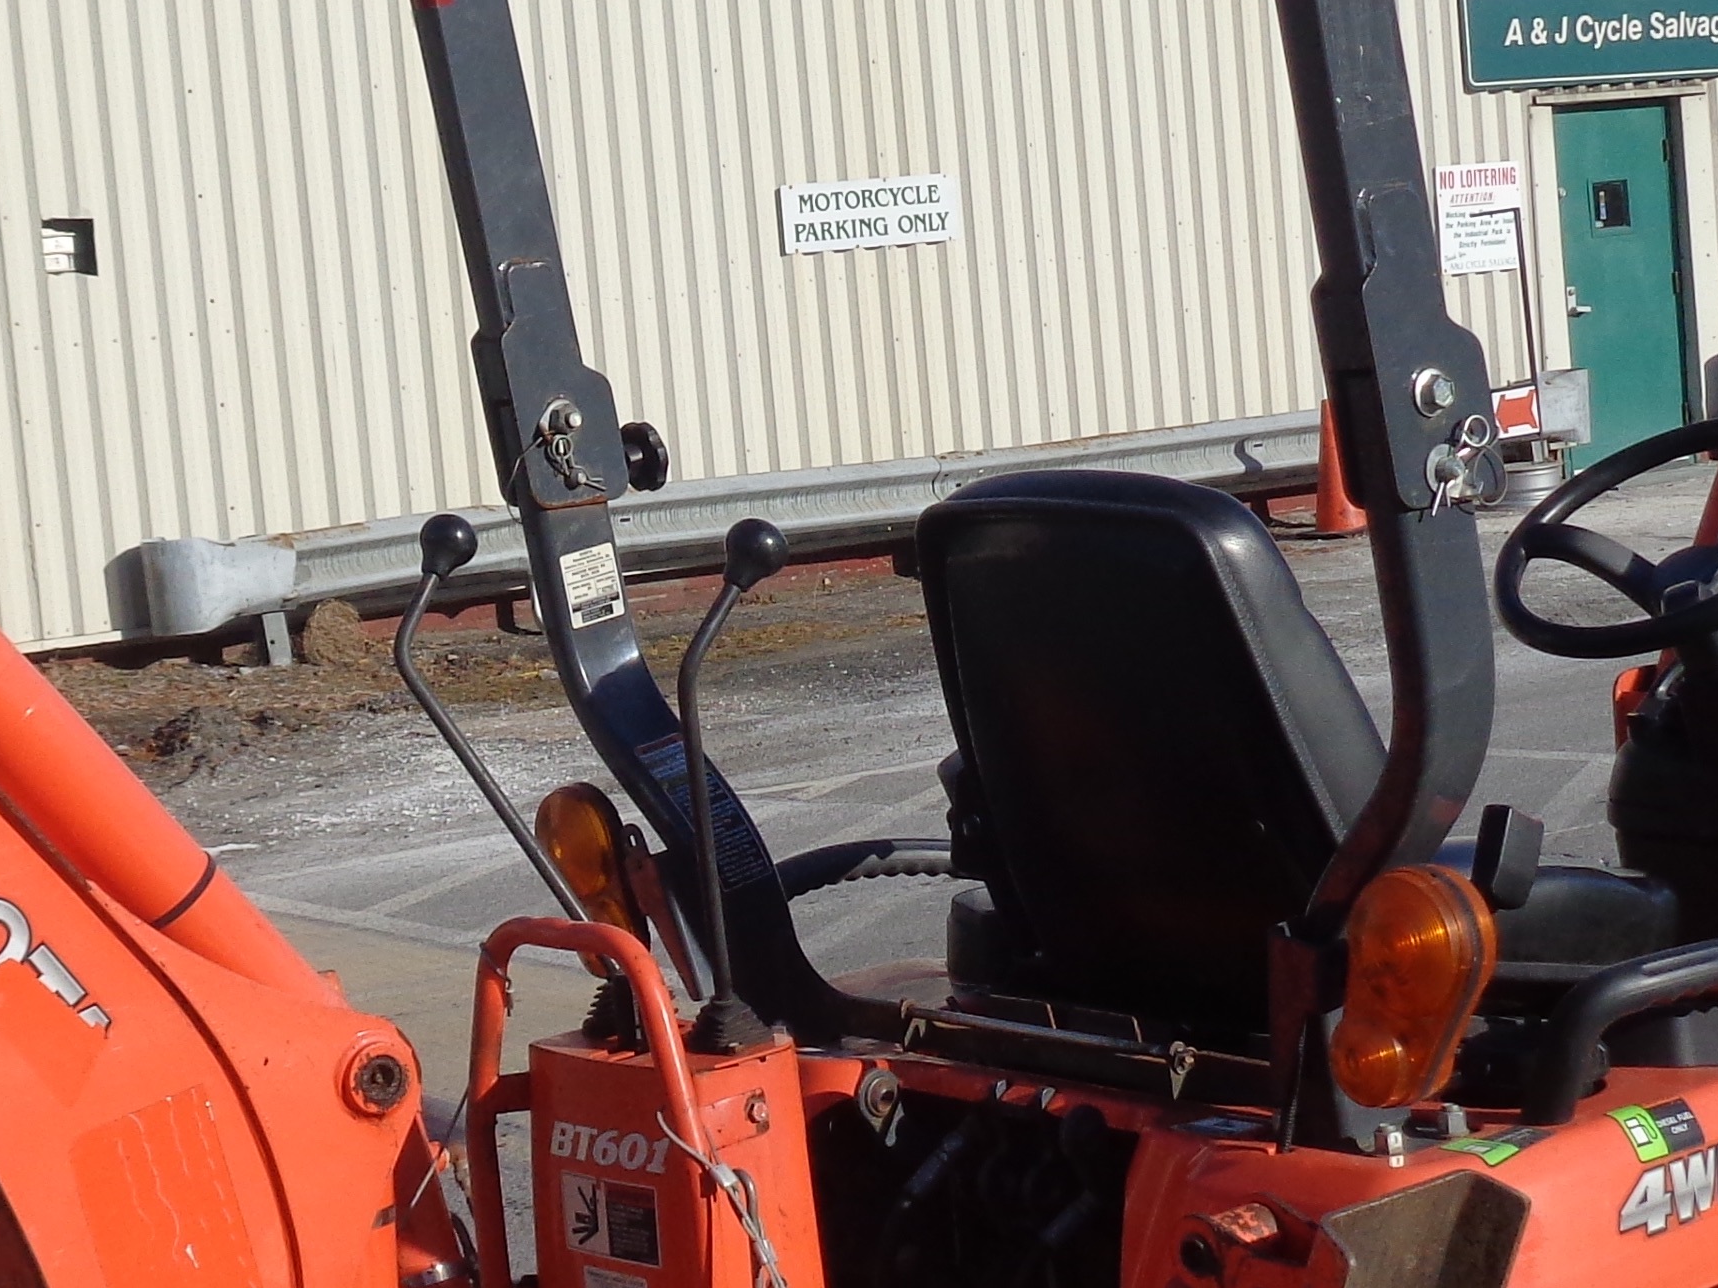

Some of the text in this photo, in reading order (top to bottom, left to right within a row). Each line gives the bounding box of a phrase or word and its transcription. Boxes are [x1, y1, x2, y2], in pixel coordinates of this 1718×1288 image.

[1504, 18, 1524, 46] A
[1530, 17, 1547, 45] &
[1554, 16, 1568, 43] J
[1575, 14, 1643, 49] Cycle
[1439, 167, 1516, 190] NO LOITERING
[798, 184, 940, 213] MOTORCYCLE
[794, 212, 950, 242] PARKING ONLY
[1655, 1111, 1694, 1128] DIESEL FUEL
[550, 1121, 671, 1174] BT601
